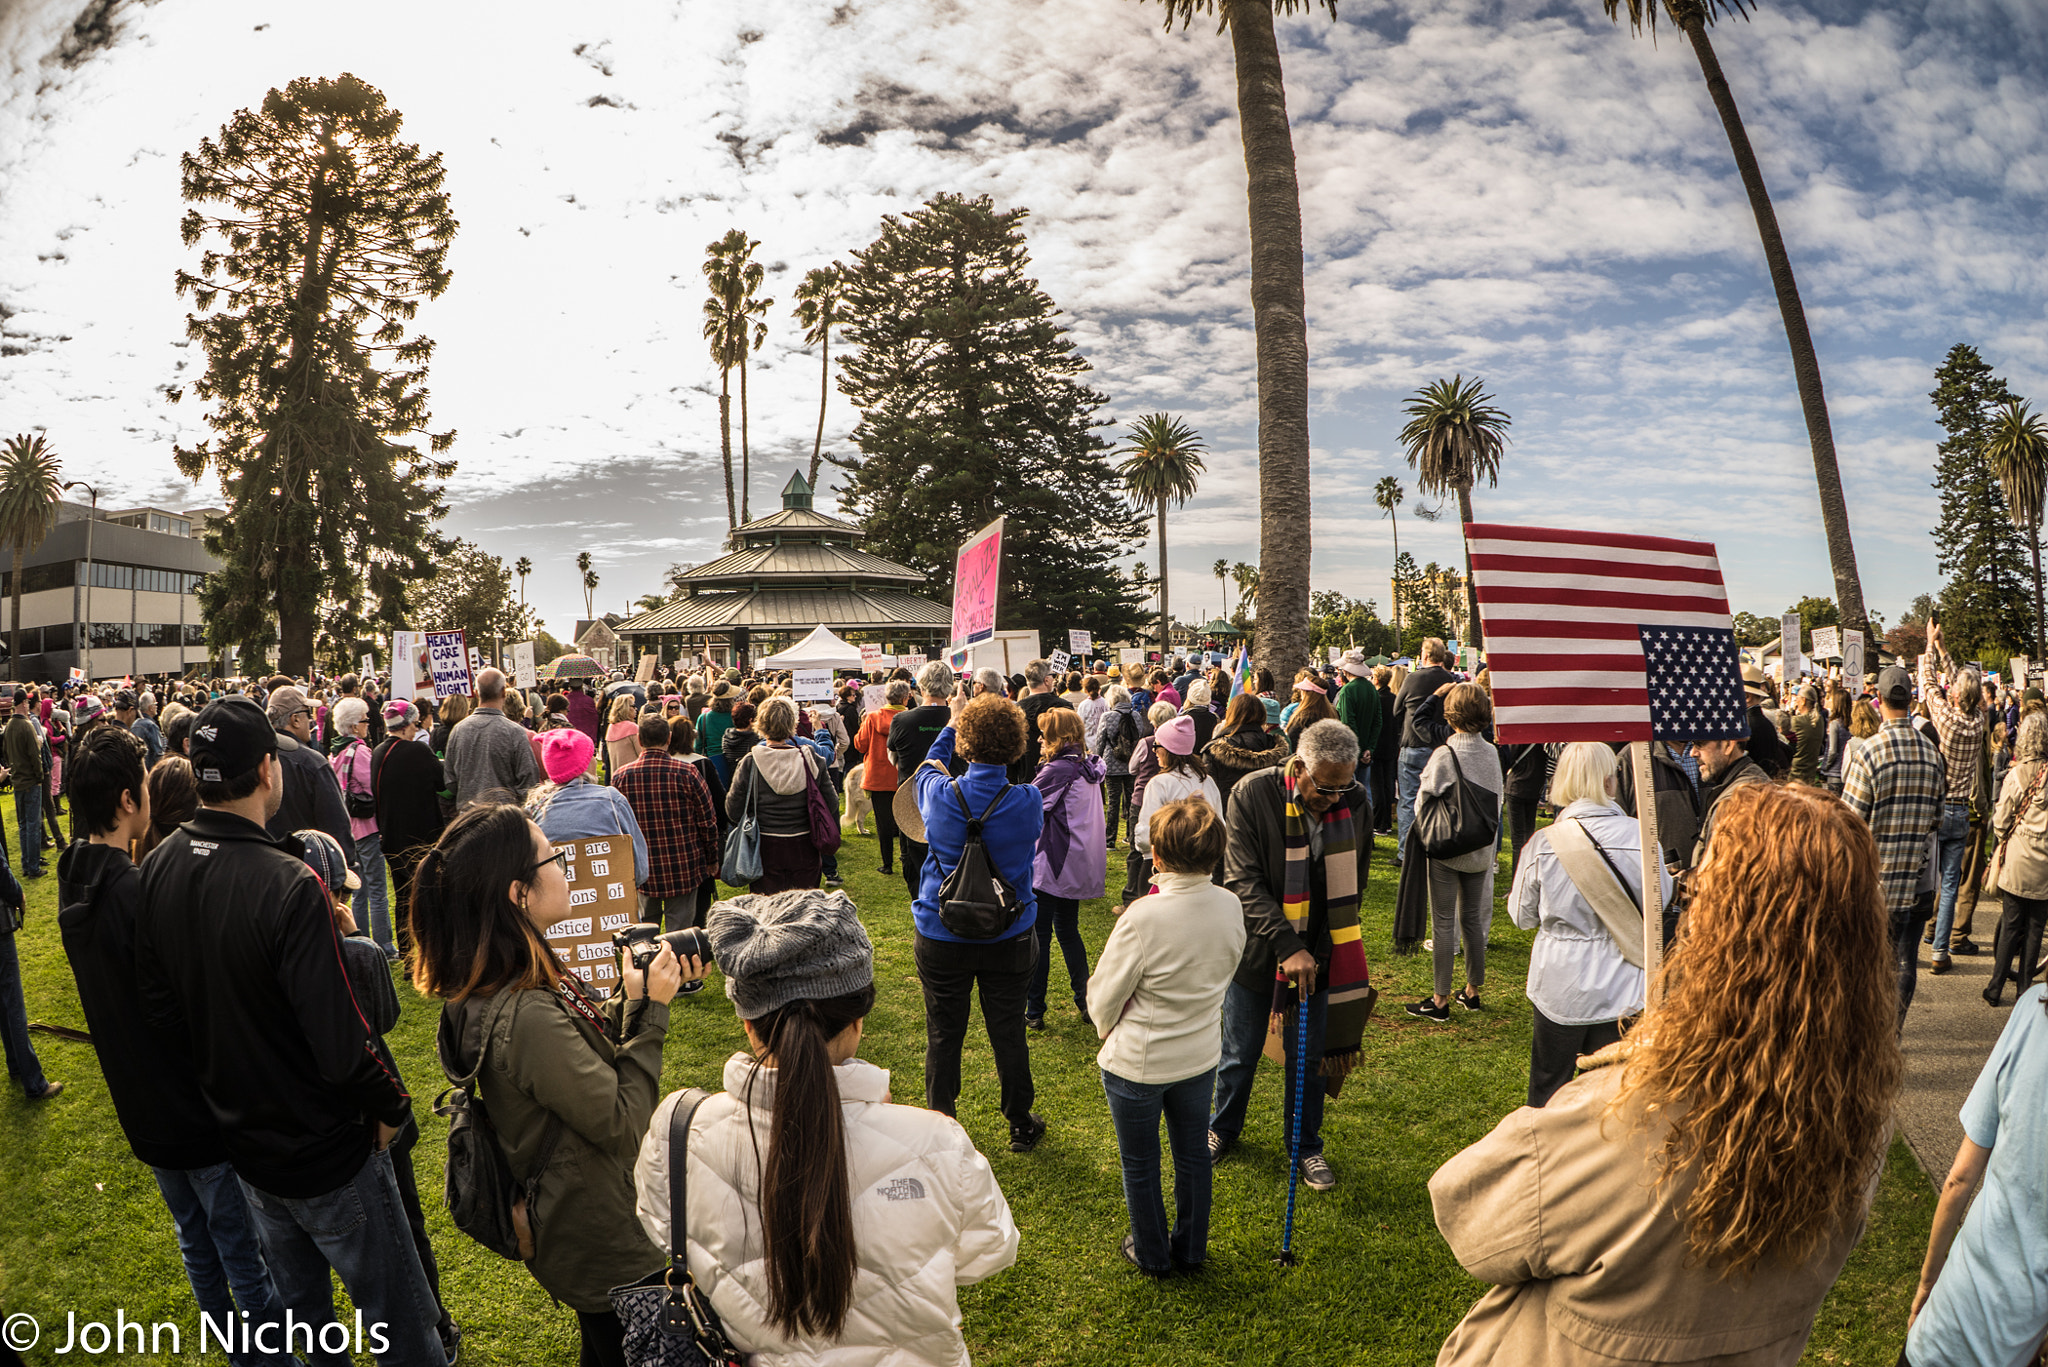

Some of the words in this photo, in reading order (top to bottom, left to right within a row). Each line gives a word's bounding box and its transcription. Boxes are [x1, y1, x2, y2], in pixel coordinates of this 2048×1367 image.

[426, 632, 462, 648] HEALTH
[432, 646, 459, 660] CARE
[440, 661, 448, 669] IS
[451, 660, 459, 669] A
[899, 656, 928, 665] LIBERTY
[433, 669, 468, 683] HUMAN
[436, 682, 468, 696] RIGHT
[189, 839, 220, 849] MANCHESTER
[585, 842, 609, 854] are
[592, 861, 607, 875] in
[571, 890, 597, 904] ons
[608, 883, 623, 898] of
[601, 912, 629, 930] you
[597, 964, 612, 979] of
[559, 981, 577, 1001] OS
[890, 1177, 909, 1187] THE
[876, 1185, 909, 1196] NORTH
[887, 1192, 910, 1201] FACE
